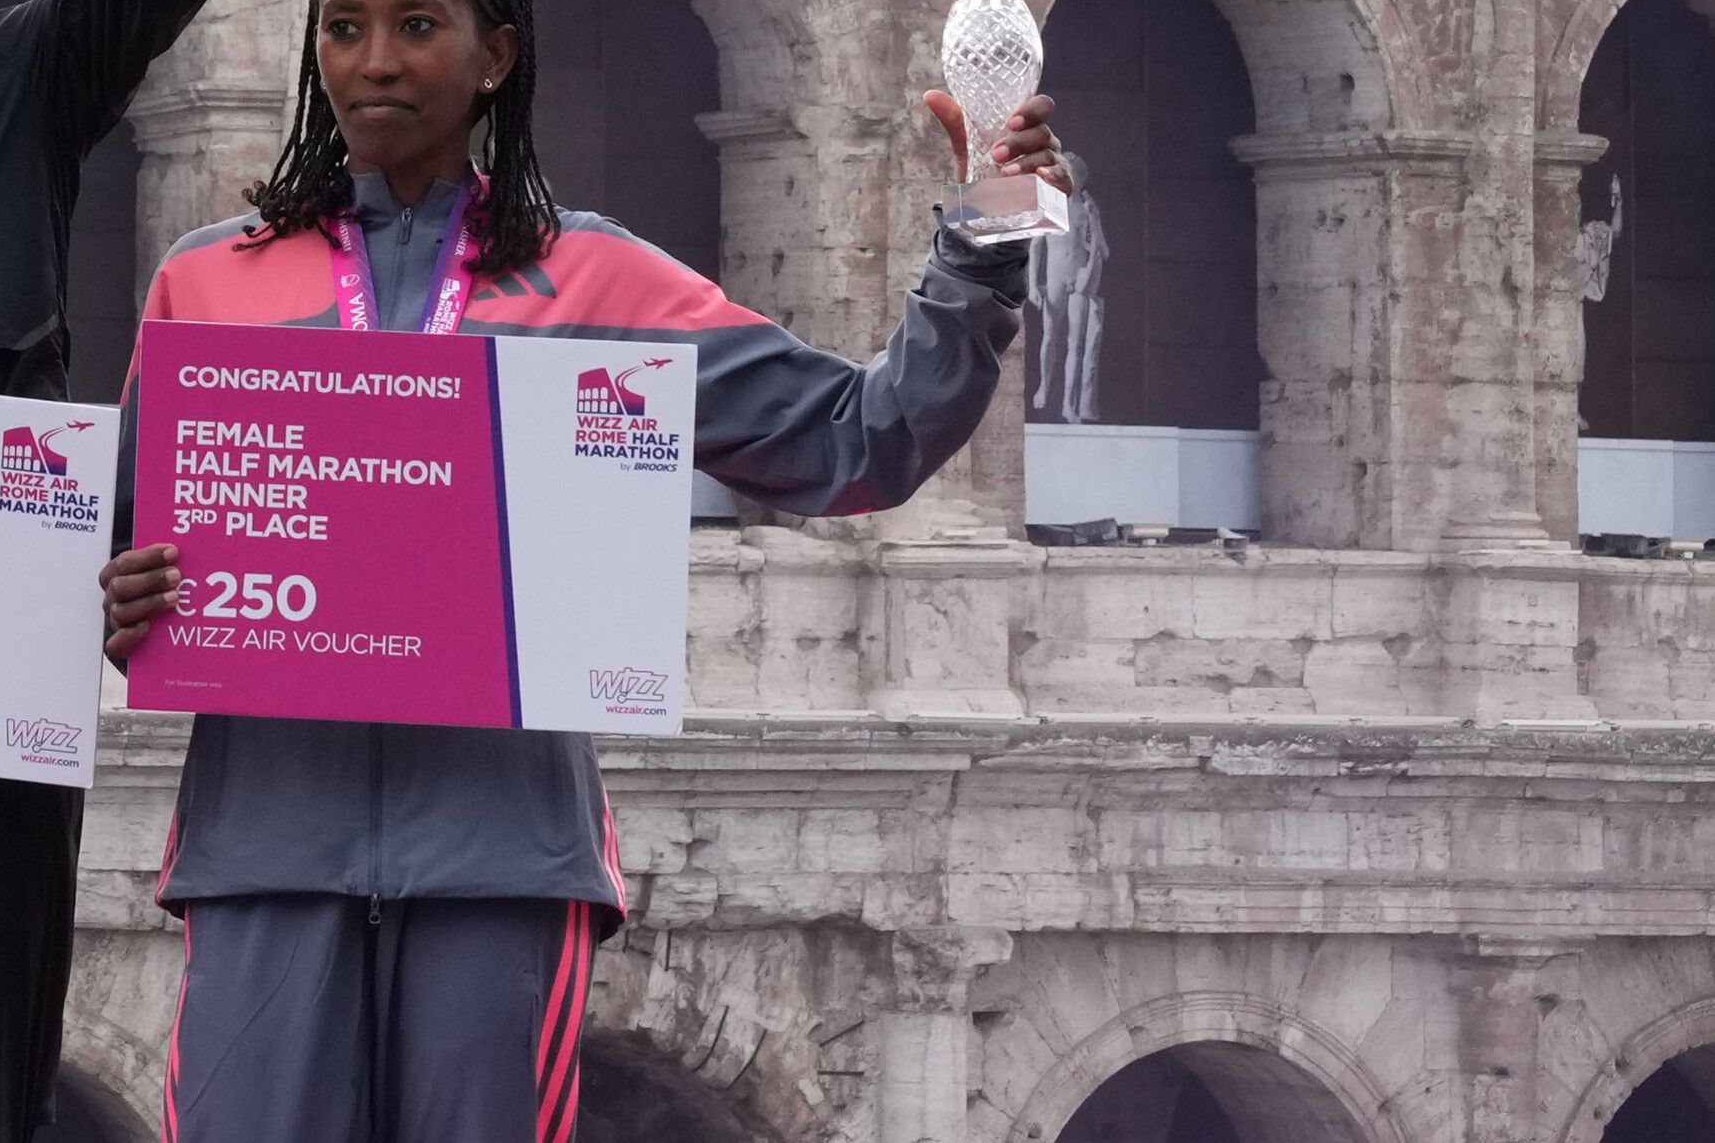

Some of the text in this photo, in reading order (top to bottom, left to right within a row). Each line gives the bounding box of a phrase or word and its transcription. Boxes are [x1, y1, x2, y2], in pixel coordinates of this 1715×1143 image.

[348, 292, 368, 331] OMA
[178, 365, 461, 399] CONGRATULATIONS!
[577, 415, 658, 431] WIZZ AIR
[176, 419, 305, 451] FEMALE
[575, 430, 680, 446] ROME HALF
[575, 444, 678, 460] MARATHON
[175, 449, 452, 487] HALF MARATHON
[620, 462, 678, 472] by BROOKS
[1, 471, 79, 492] WIZZ AIR
[0, 485, 99, 507] ROME HALF
[173, 479, 307, 510] RUNNER
[41, 520, 96, 533] by BROOKS
[225, 510, 329, 541] PLACE
[168, 625, 422, 657] WIZZ AIR VOUCHER
[605, 705, 667, 716] wizzair.com
[21, 754, 79, 768] wizzair.com
